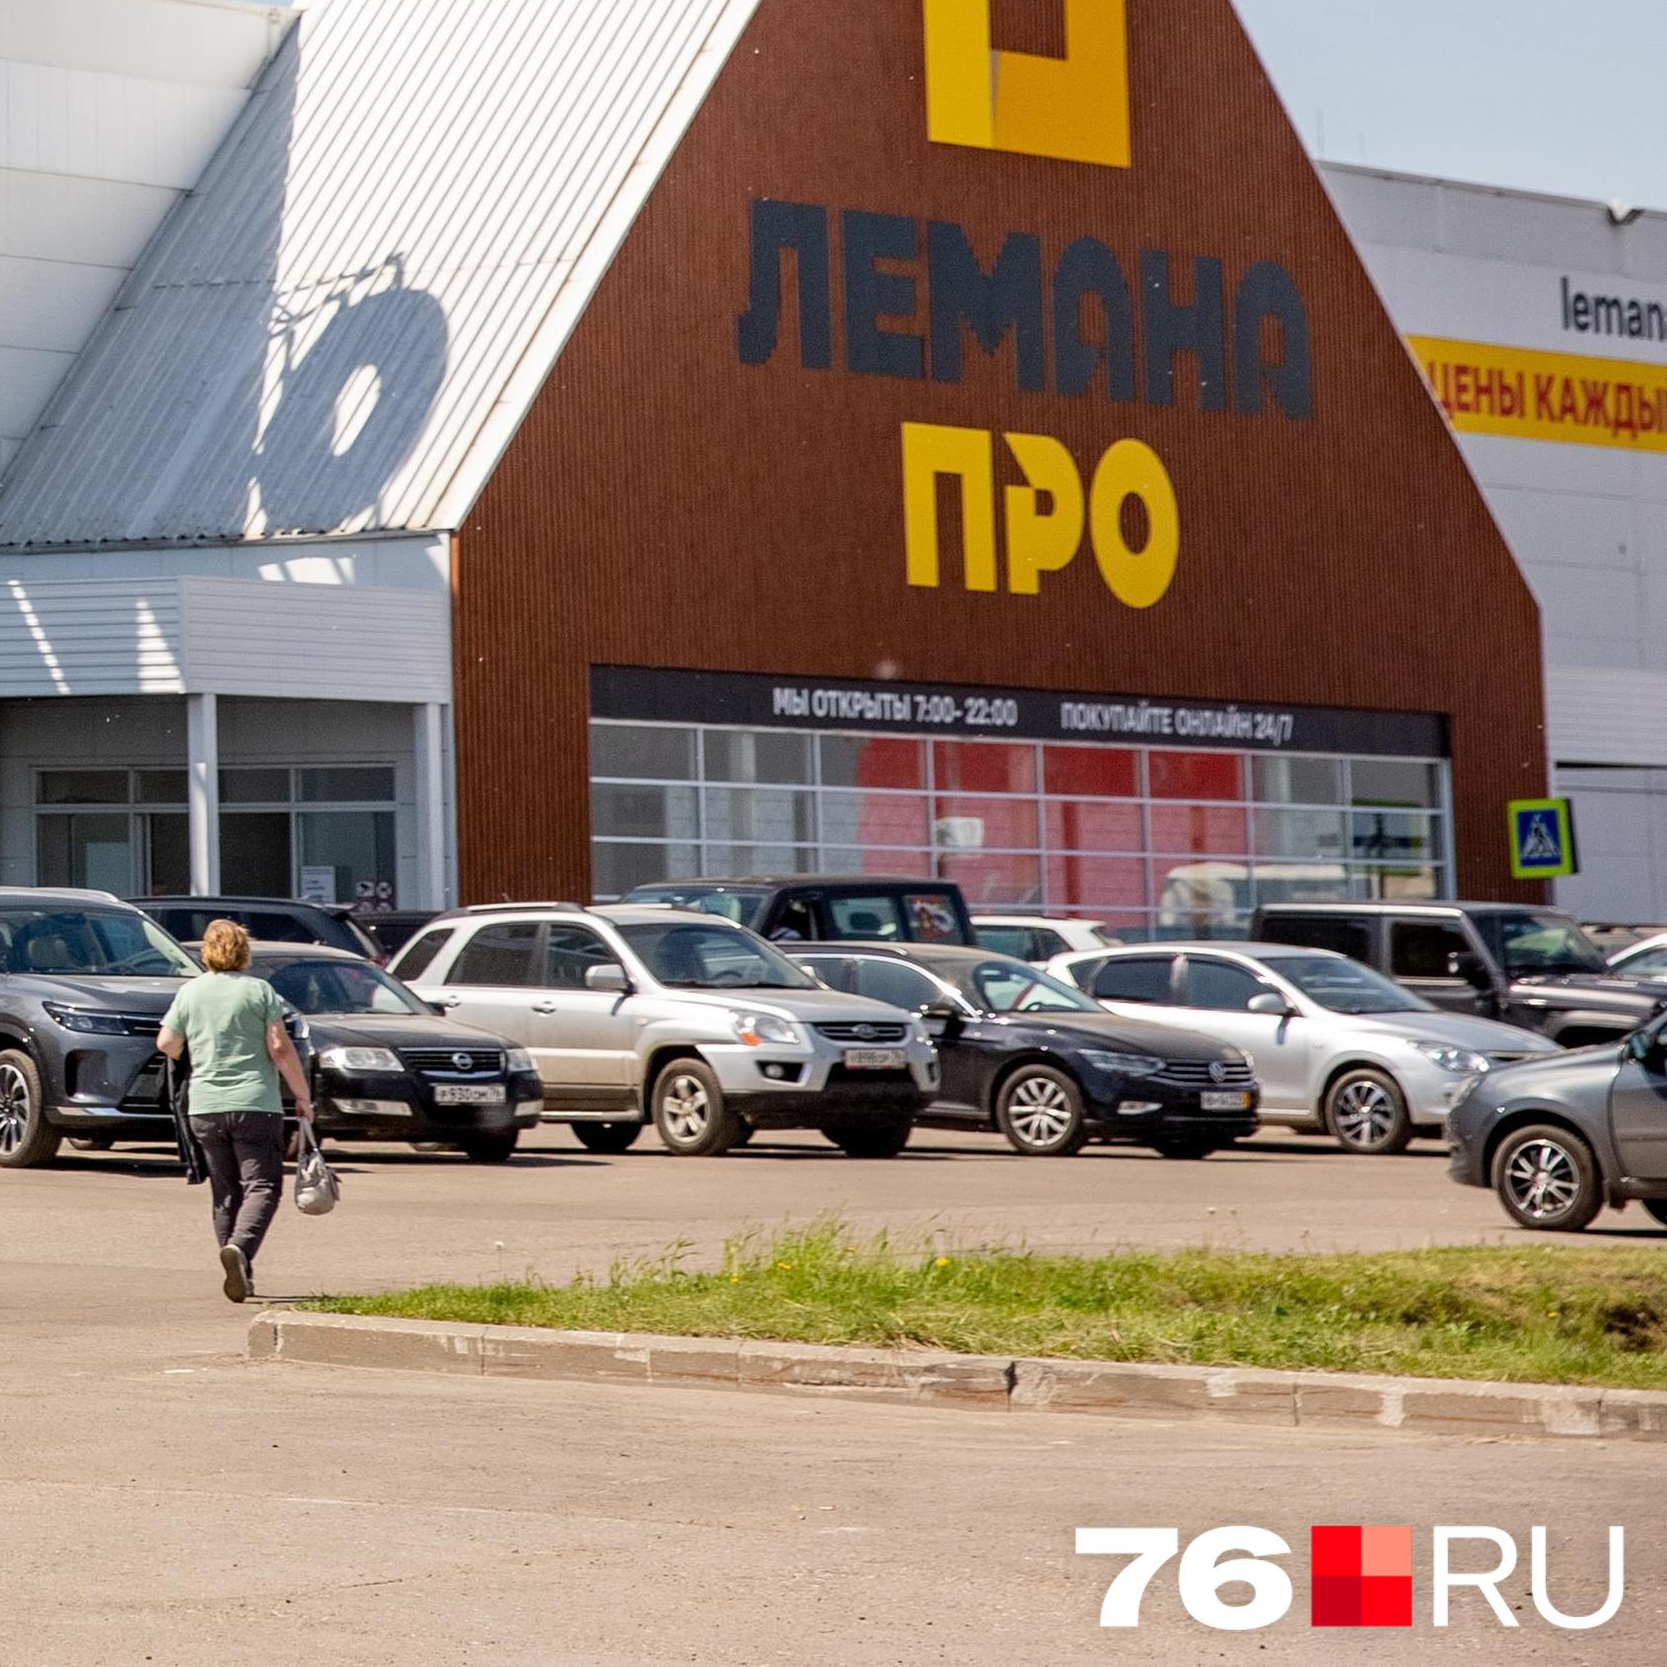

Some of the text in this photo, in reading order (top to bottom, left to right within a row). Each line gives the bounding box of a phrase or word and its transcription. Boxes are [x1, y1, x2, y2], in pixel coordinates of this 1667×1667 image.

[736, 198, 1312, 420] ЛЕМАНА
[901, 422, 1179, 609] ПРО
[772, 687, 810, 716] МЫ
[811, 689, 911, 721] ОТКРЫТЫ
[964, 696, 1018, 726] 22:00
[1060, 700, 1295, 747] ПОКУПАЙТЕ ОНЛАЙН 24/7
